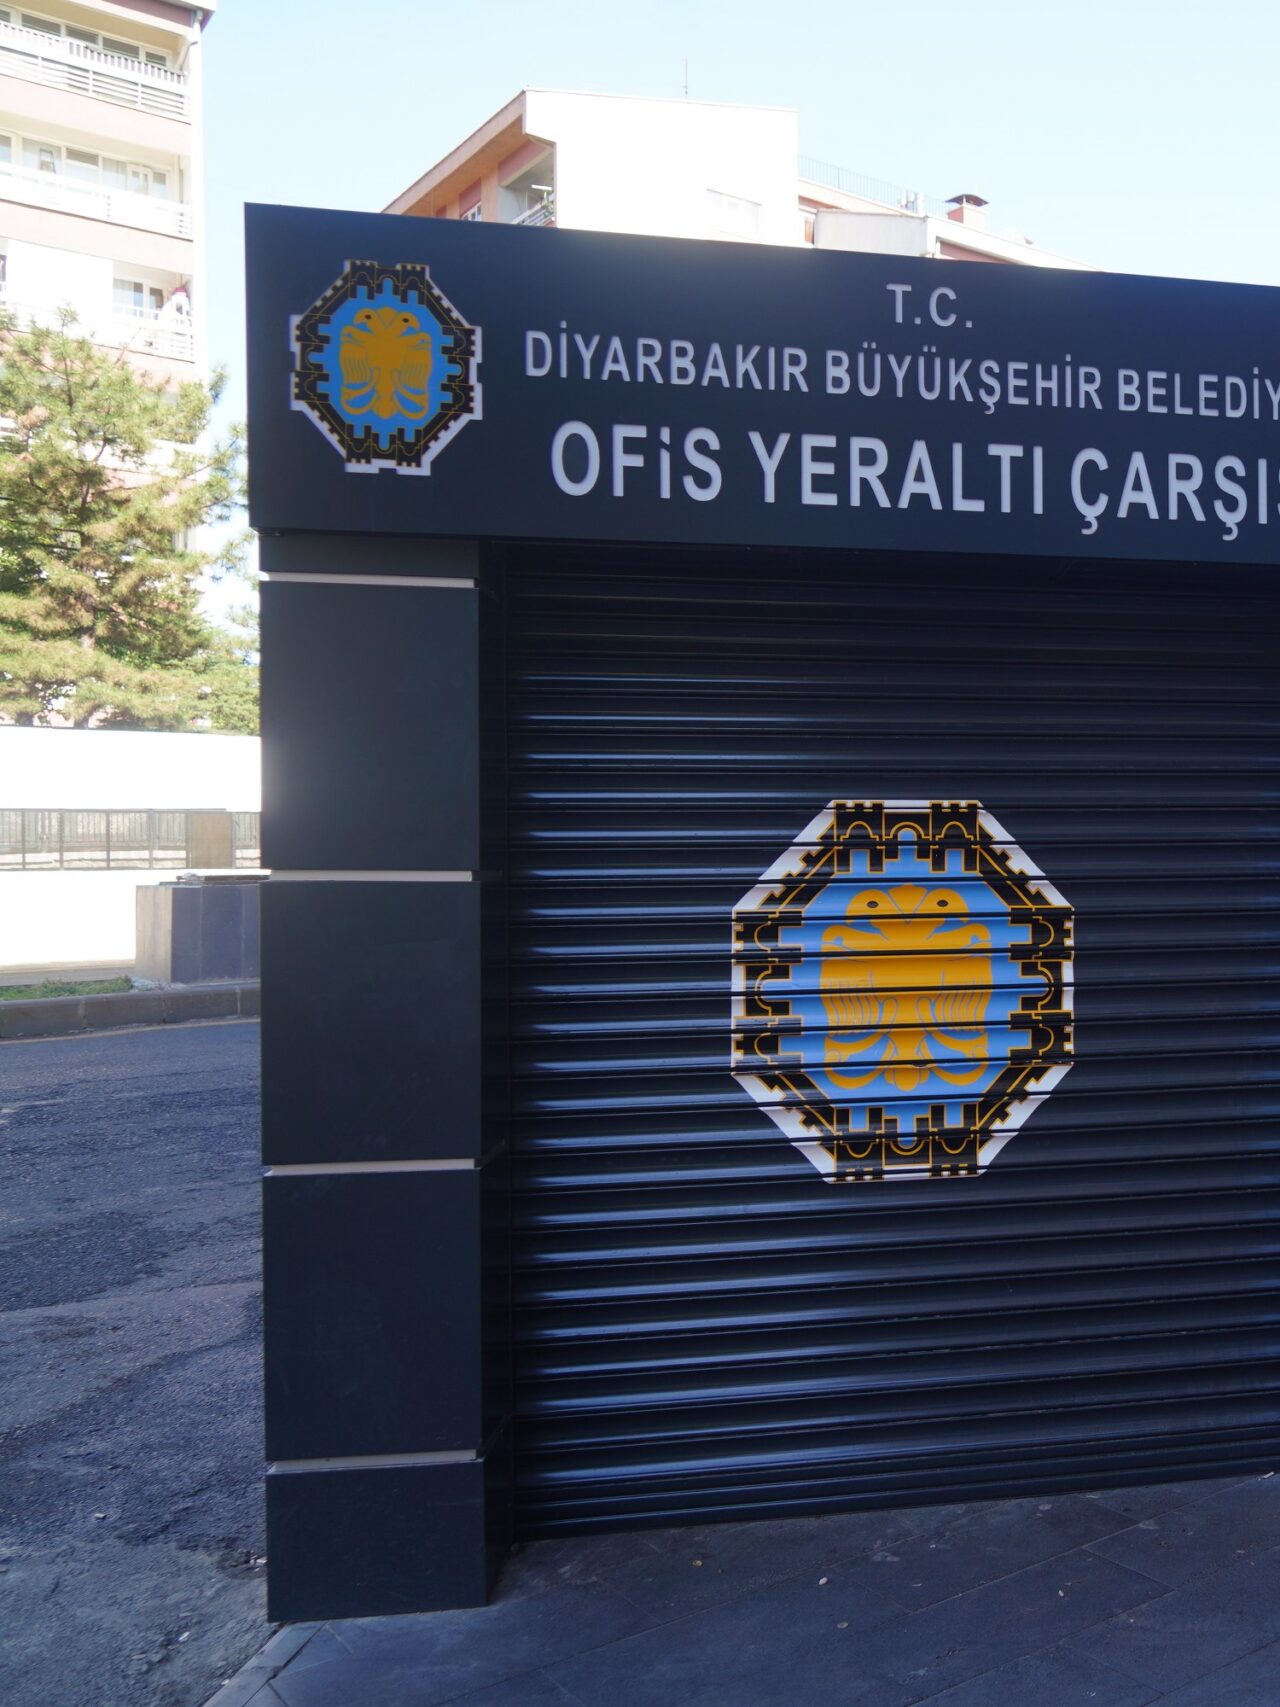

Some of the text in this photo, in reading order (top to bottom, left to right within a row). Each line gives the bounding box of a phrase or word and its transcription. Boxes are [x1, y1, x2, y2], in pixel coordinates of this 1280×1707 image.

[886, 284, 972, 328] T.C.
[525, 320, 809, 393] DİYARBAKIR
[826, 341, 1102, 414] BÜYÜKŞEHİR
[748, 430, 1043, 515] YERALTI
